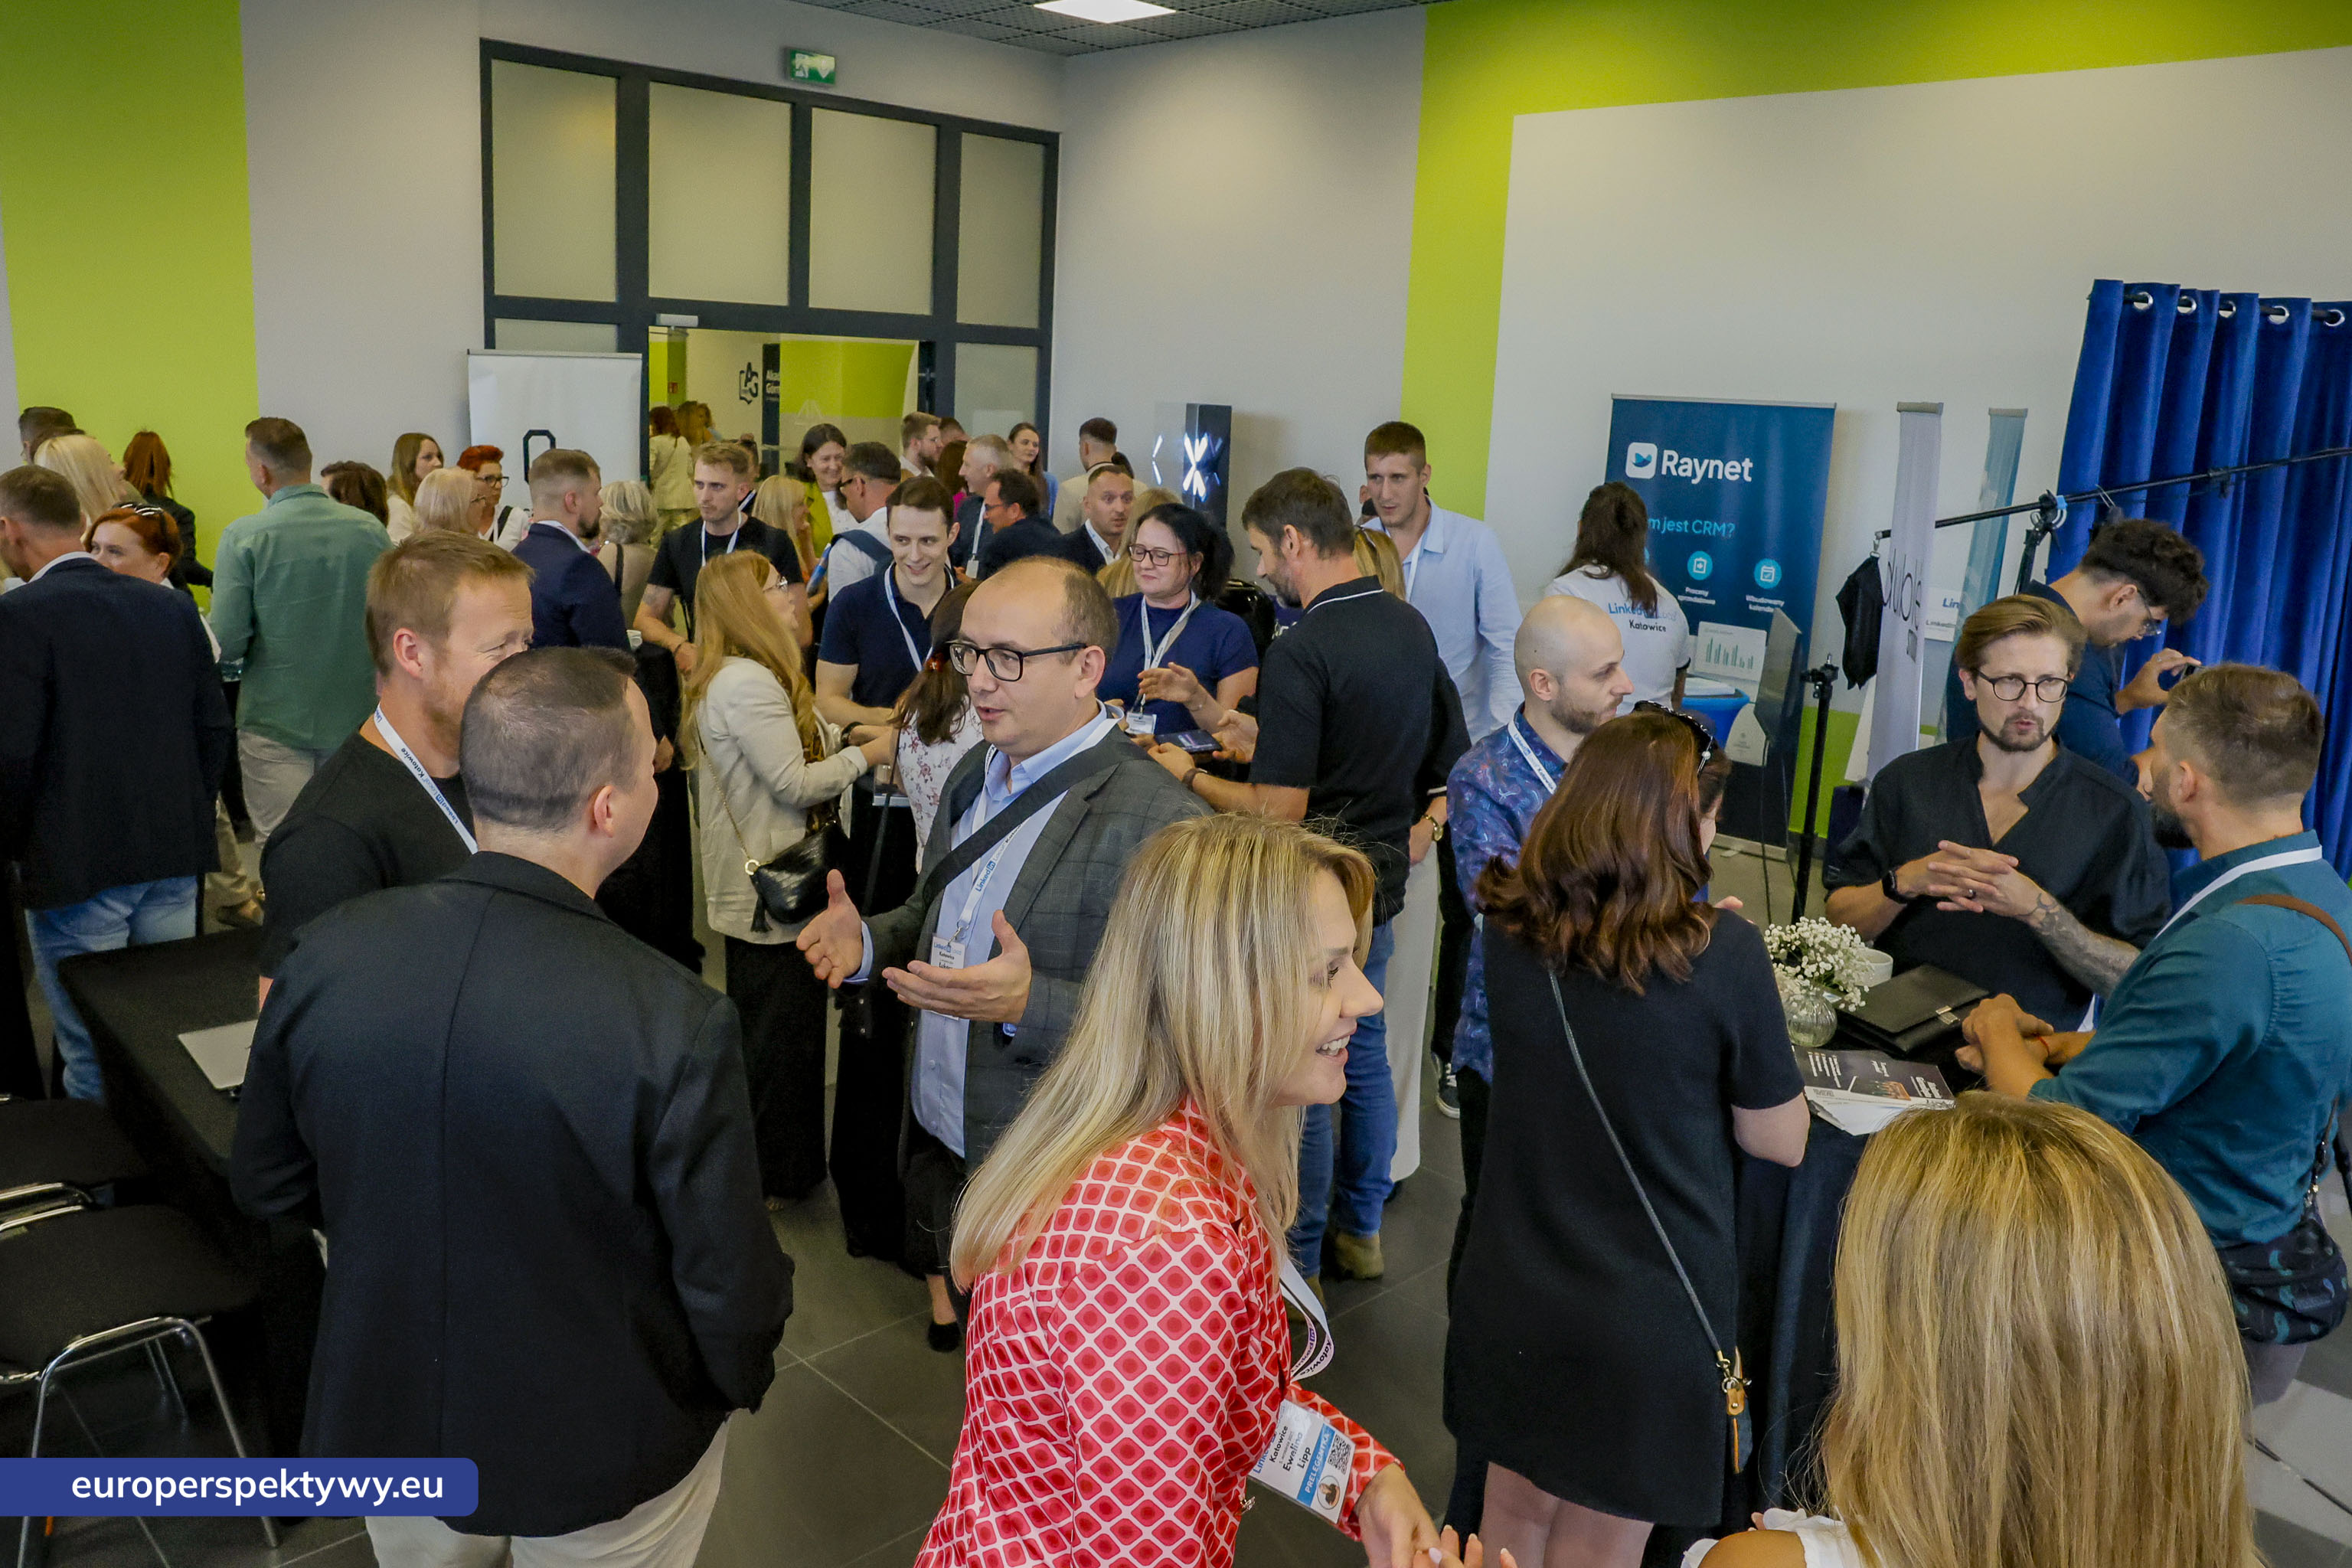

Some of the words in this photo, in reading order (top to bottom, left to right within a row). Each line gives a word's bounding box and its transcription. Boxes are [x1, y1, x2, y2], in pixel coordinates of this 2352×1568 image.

[1661, 449, 1753, 484] Raynet
[1661, 517, 1689, 534] jest
[1692, 519, 1736, 537] CRM?
[1629, 619, 1667, 632] Katowice
[400, 747, 425, 779] Katowice
[1299, 1340, 1331, 1377] Katowice
[1269, 1426, 1289, 1463] Katowice
[1282, 1432, 1303, 1472] Ewelina
[1297, 1446, 1312, 1469] Lipp
